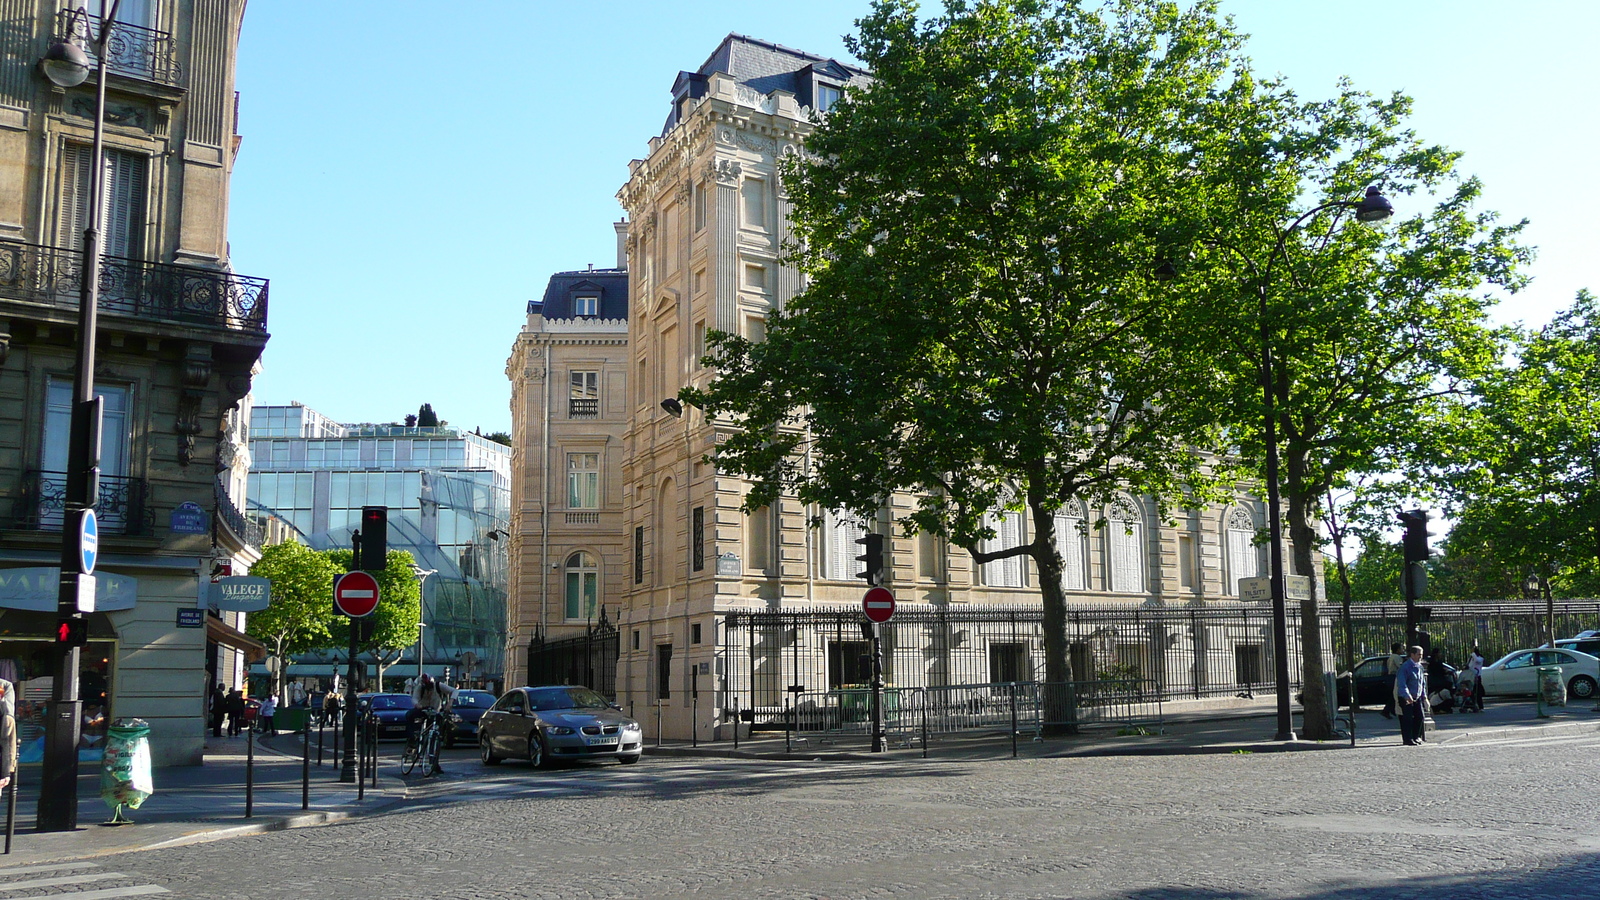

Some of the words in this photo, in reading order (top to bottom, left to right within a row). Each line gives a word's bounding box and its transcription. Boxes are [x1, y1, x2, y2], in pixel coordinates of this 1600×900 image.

[221, 584, 265, 596] VALEGE
[1244, 589, 1266, 597] TILSITT
[223, 593, 263, 602] Lingerie
